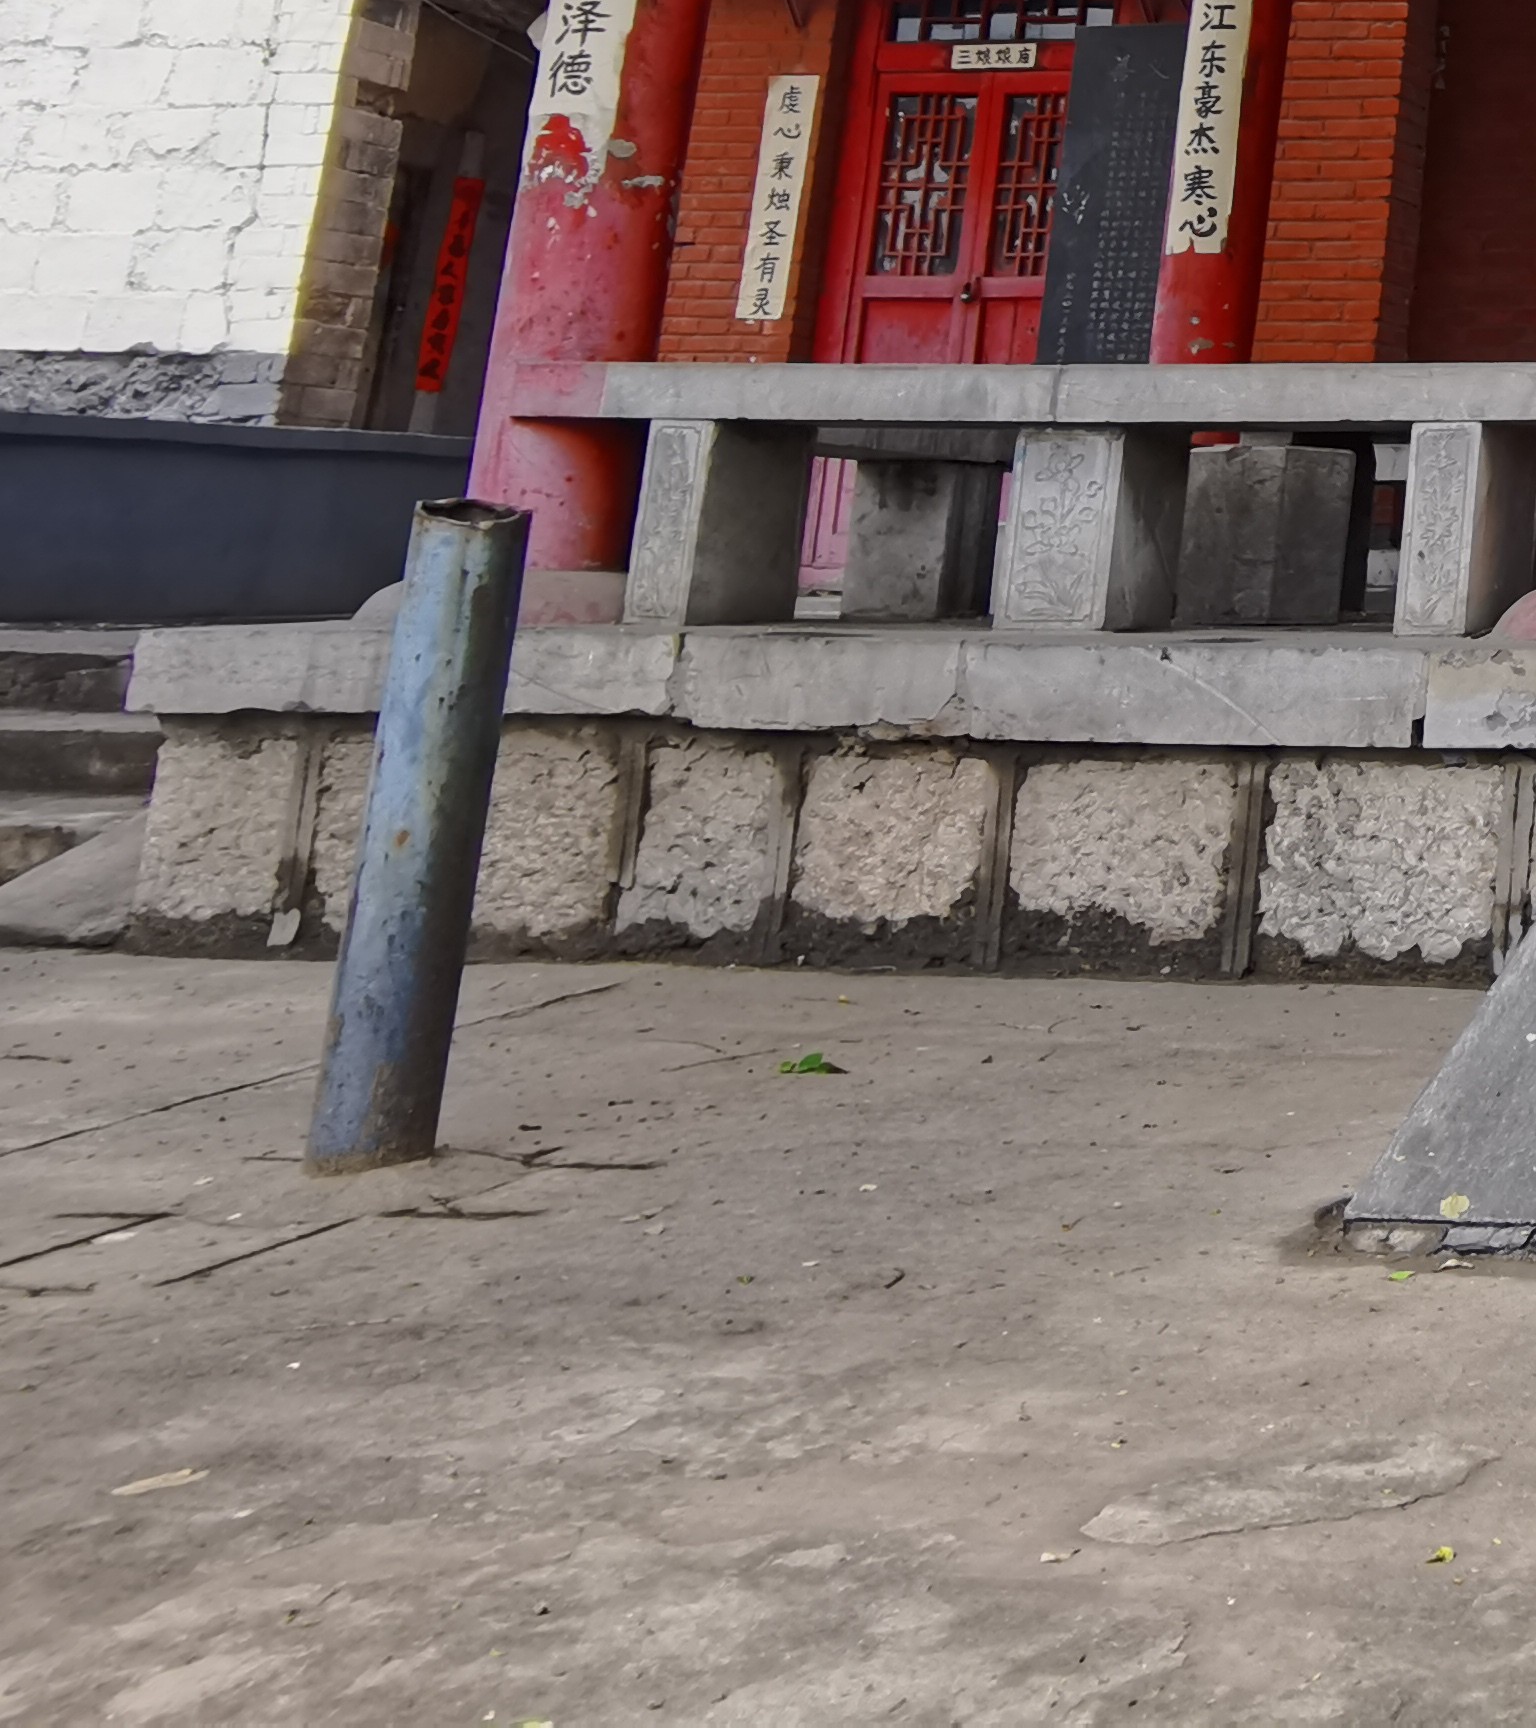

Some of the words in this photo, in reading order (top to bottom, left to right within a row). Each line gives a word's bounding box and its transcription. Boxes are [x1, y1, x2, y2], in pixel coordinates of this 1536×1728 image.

[749, 85, 802, 316] 虔心秉烛圣有灵
